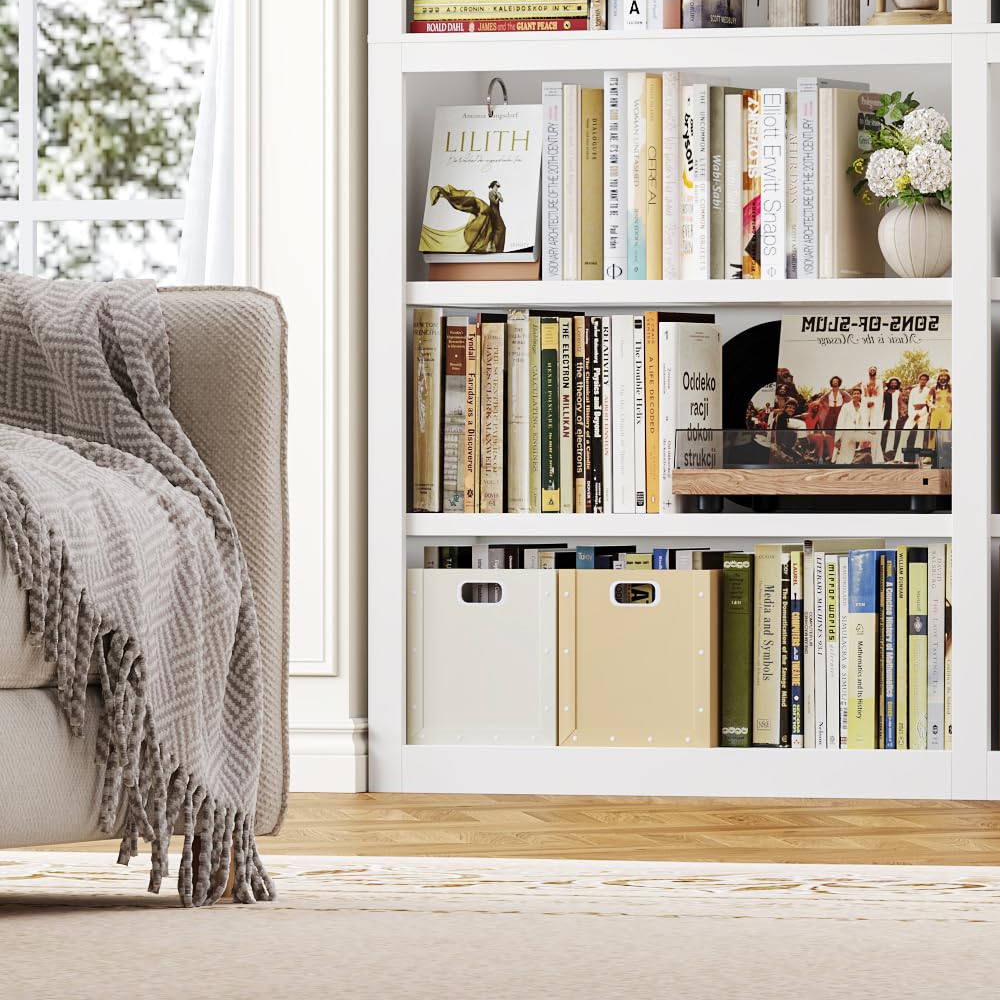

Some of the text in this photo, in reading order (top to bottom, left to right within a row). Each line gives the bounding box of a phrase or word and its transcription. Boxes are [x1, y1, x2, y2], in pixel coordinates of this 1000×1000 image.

[426, 23, 464, 32] ROALD DAHL
[444, 130, 530, 153] LILITH
[683, 113, 693, 171] bryson
[648, 146, 657, 205] CEREAL
[713, 155, 721, 210] Wabi-Sabi
[764, 93, 781, 256] Elliott Erwitt Snaps
[468, 333, 476, 360] Tyndall
[562, 344, 570, 389] ELECTRON
[467, 373, 476, 405] Faraday
[683, 372, 716, 391] Oddeko
[575, 381, 583, 412] theory
[690, 398, 709, 420] racji
[468, 408, 474, 418] as
[562, 395, 570, 438] MILLIKAN
[577, 415, 583, 426] of
[687, 423, 713, 441] dokon
[684, 450, 716, 469] strukcji
[762, 584, 775, 681] Media and Symbols
